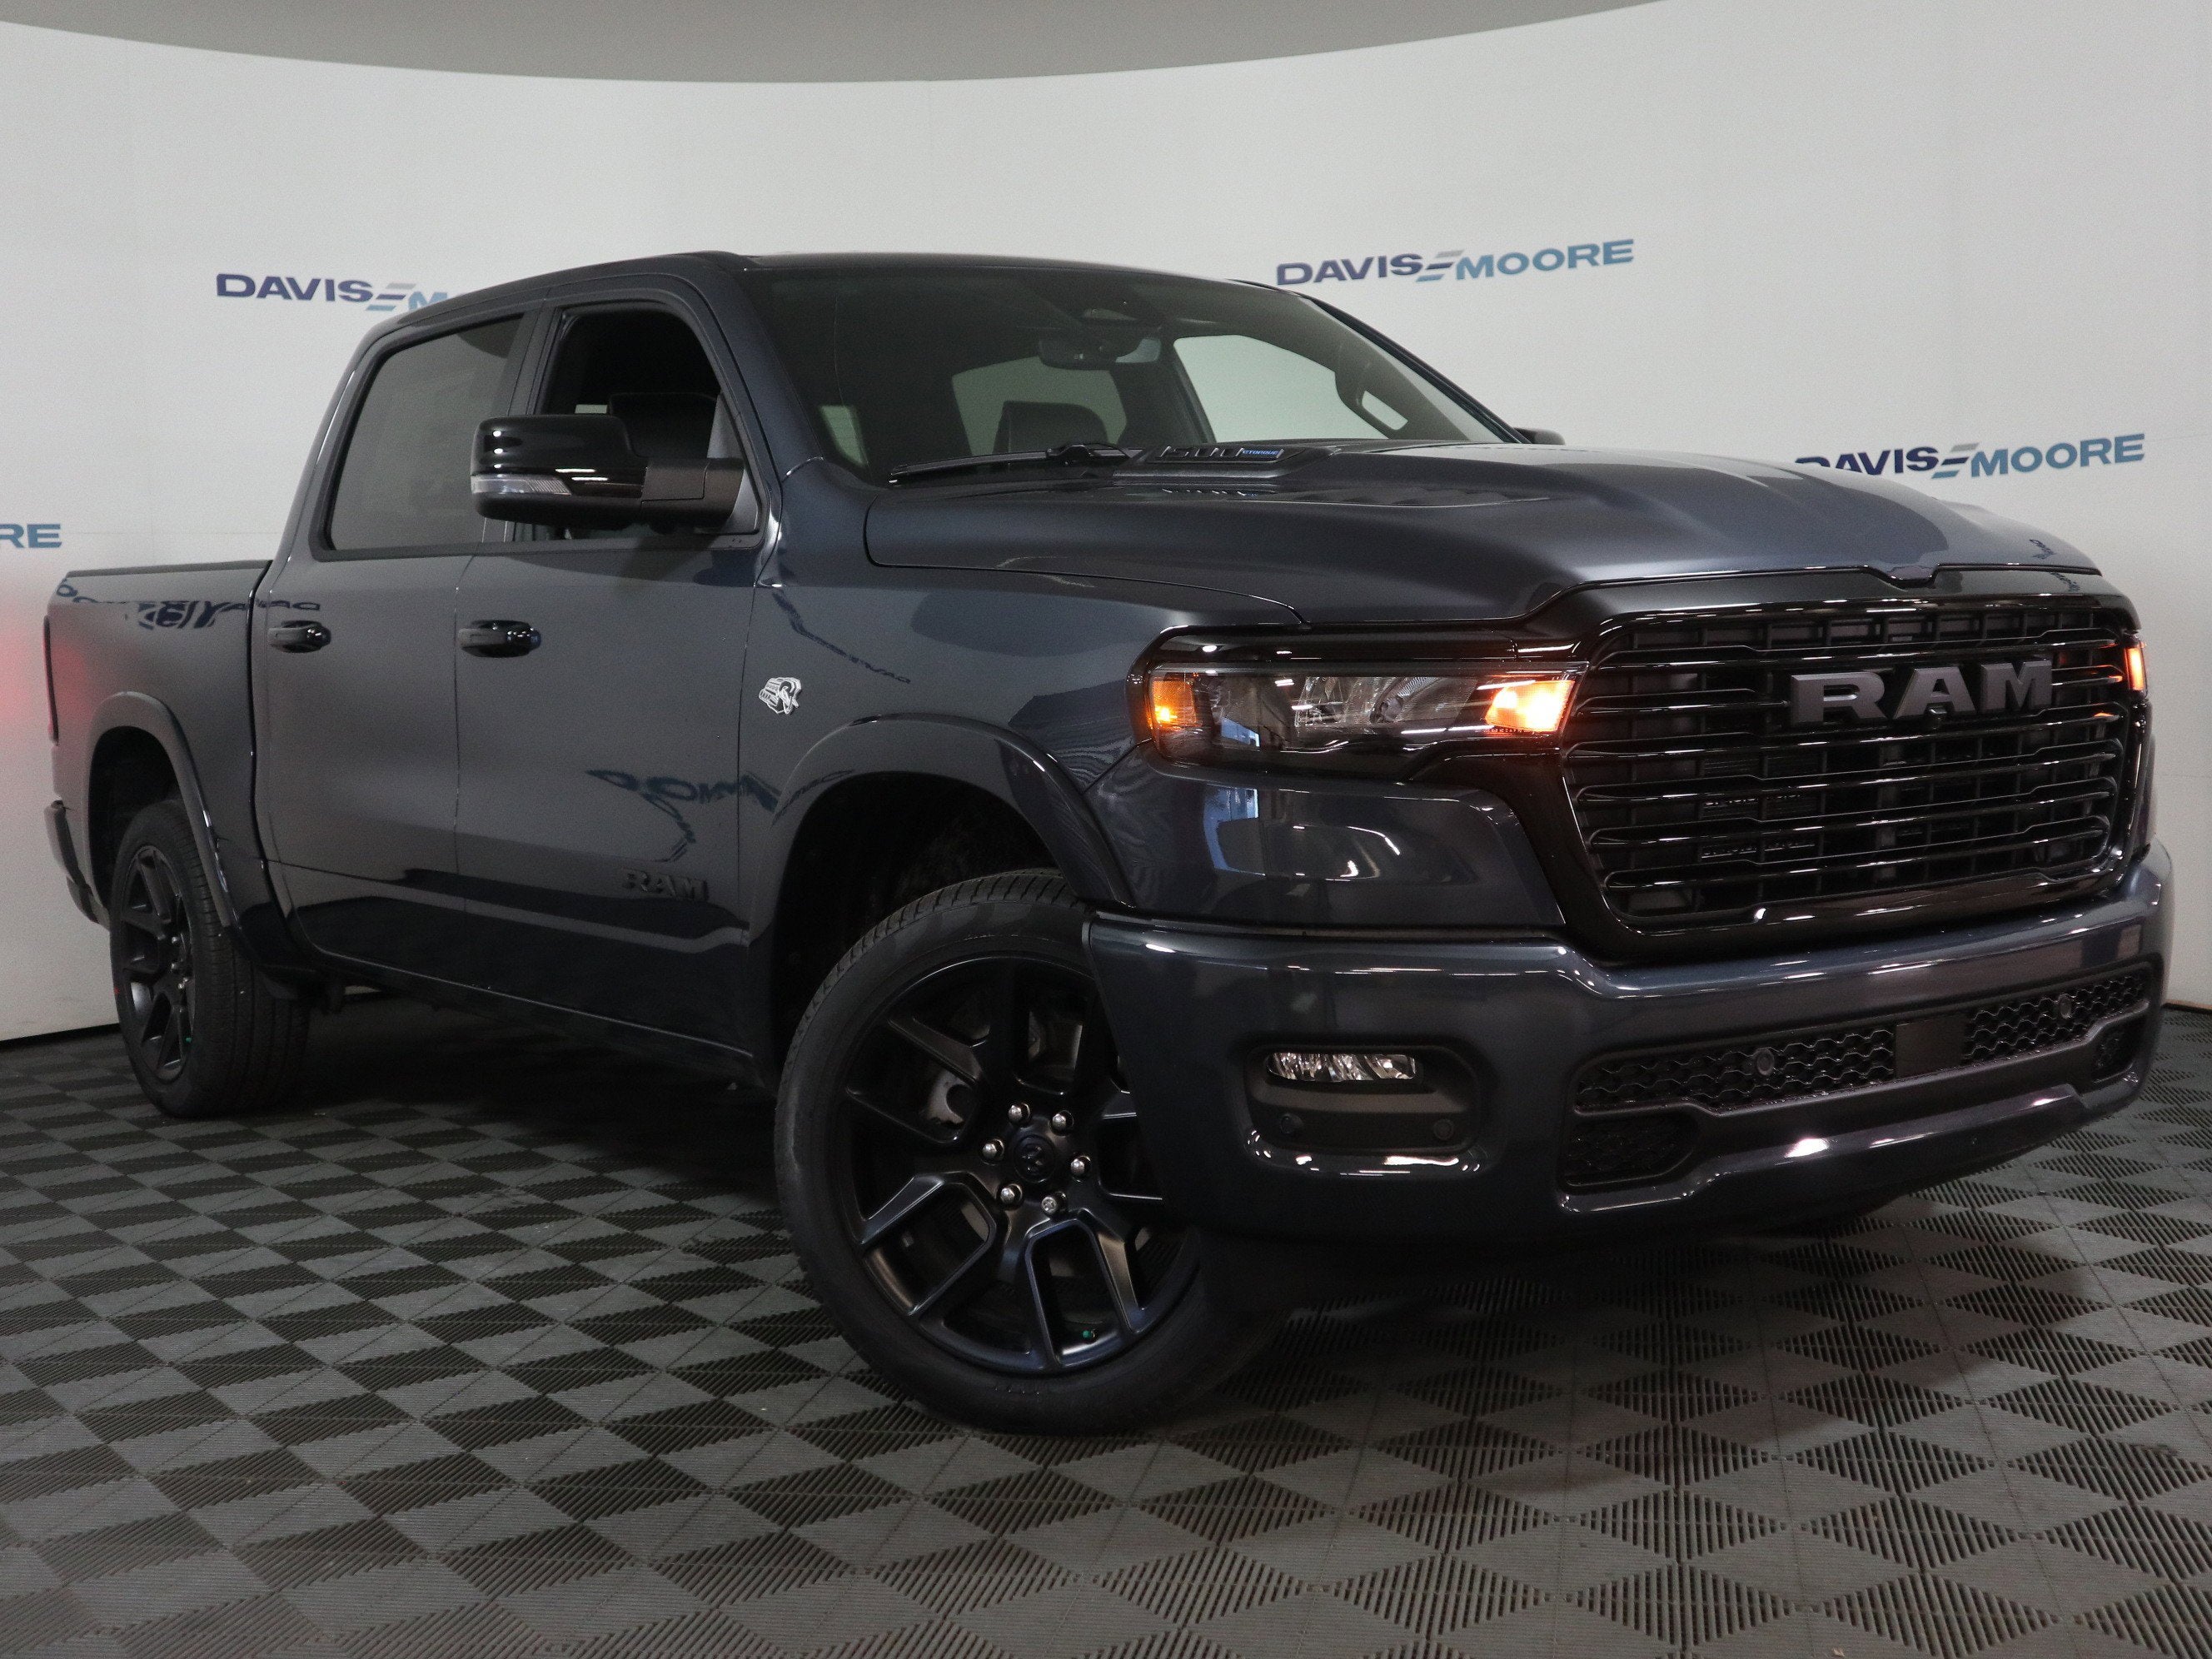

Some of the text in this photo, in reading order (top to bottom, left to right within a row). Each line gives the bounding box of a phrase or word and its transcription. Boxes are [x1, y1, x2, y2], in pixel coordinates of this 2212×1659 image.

[1276, 238, 1634, 286] DAVIS MOORE
[216, 273, 374, 302] DAVIS
[1970, 433, 2145, 478] MOORE
[1790, 659, 2054, 725] RAM
